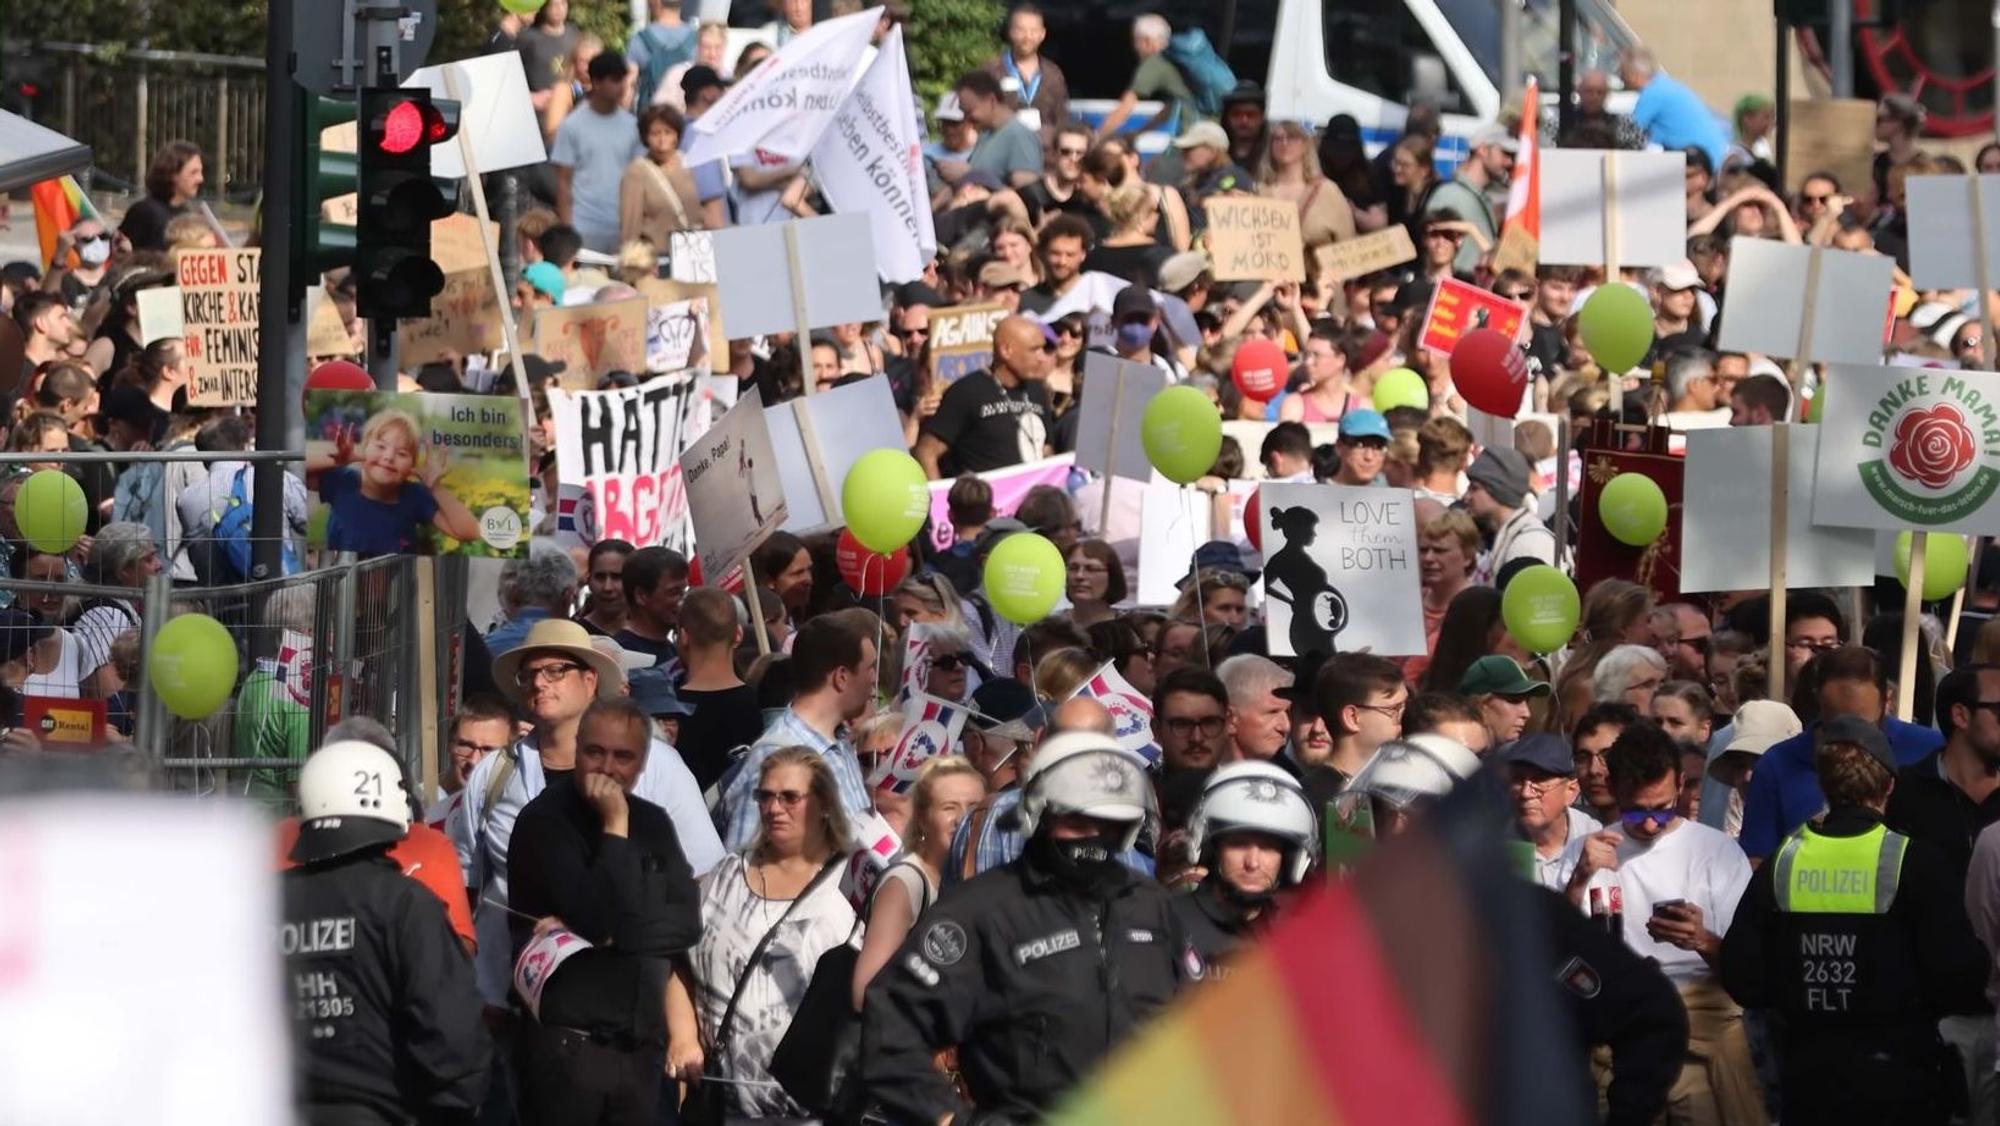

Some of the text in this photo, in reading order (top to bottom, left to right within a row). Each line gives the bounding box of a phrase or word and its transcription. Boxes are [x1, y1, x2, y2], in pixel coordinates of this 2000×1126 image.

[1212, 204, 1292, 232] WICHSEN
[1250, 231, 1277, 249] IST
[180, 255, 228, 286] GEGEN
[183, 290, 226, 324] KIRCHE
[451, 405, 506, 424] Ich bin
[1862, 374, 2000, 456] DANKE MAMA!
[432, 429, 524, 449] besonders!
[687, 457, 712, 484] Danke,
[1340, 501, 1402, 525] LOVE
[1341, 546, 1407, 571] BOTH
[353, 769, 382, 797] 21
[1796, 868, 1869, 895] POLIZEI
[278, 917, 356, 955] OLIZEI
[1018, 928, 1081, 966] POLIZEI
[1801, 932, 1857, 957] NRW
[295, 972, 338, 998] HH
[1803, 960, 1857, 984] 2632
[1808, 988, 1852, 1011] FLT
